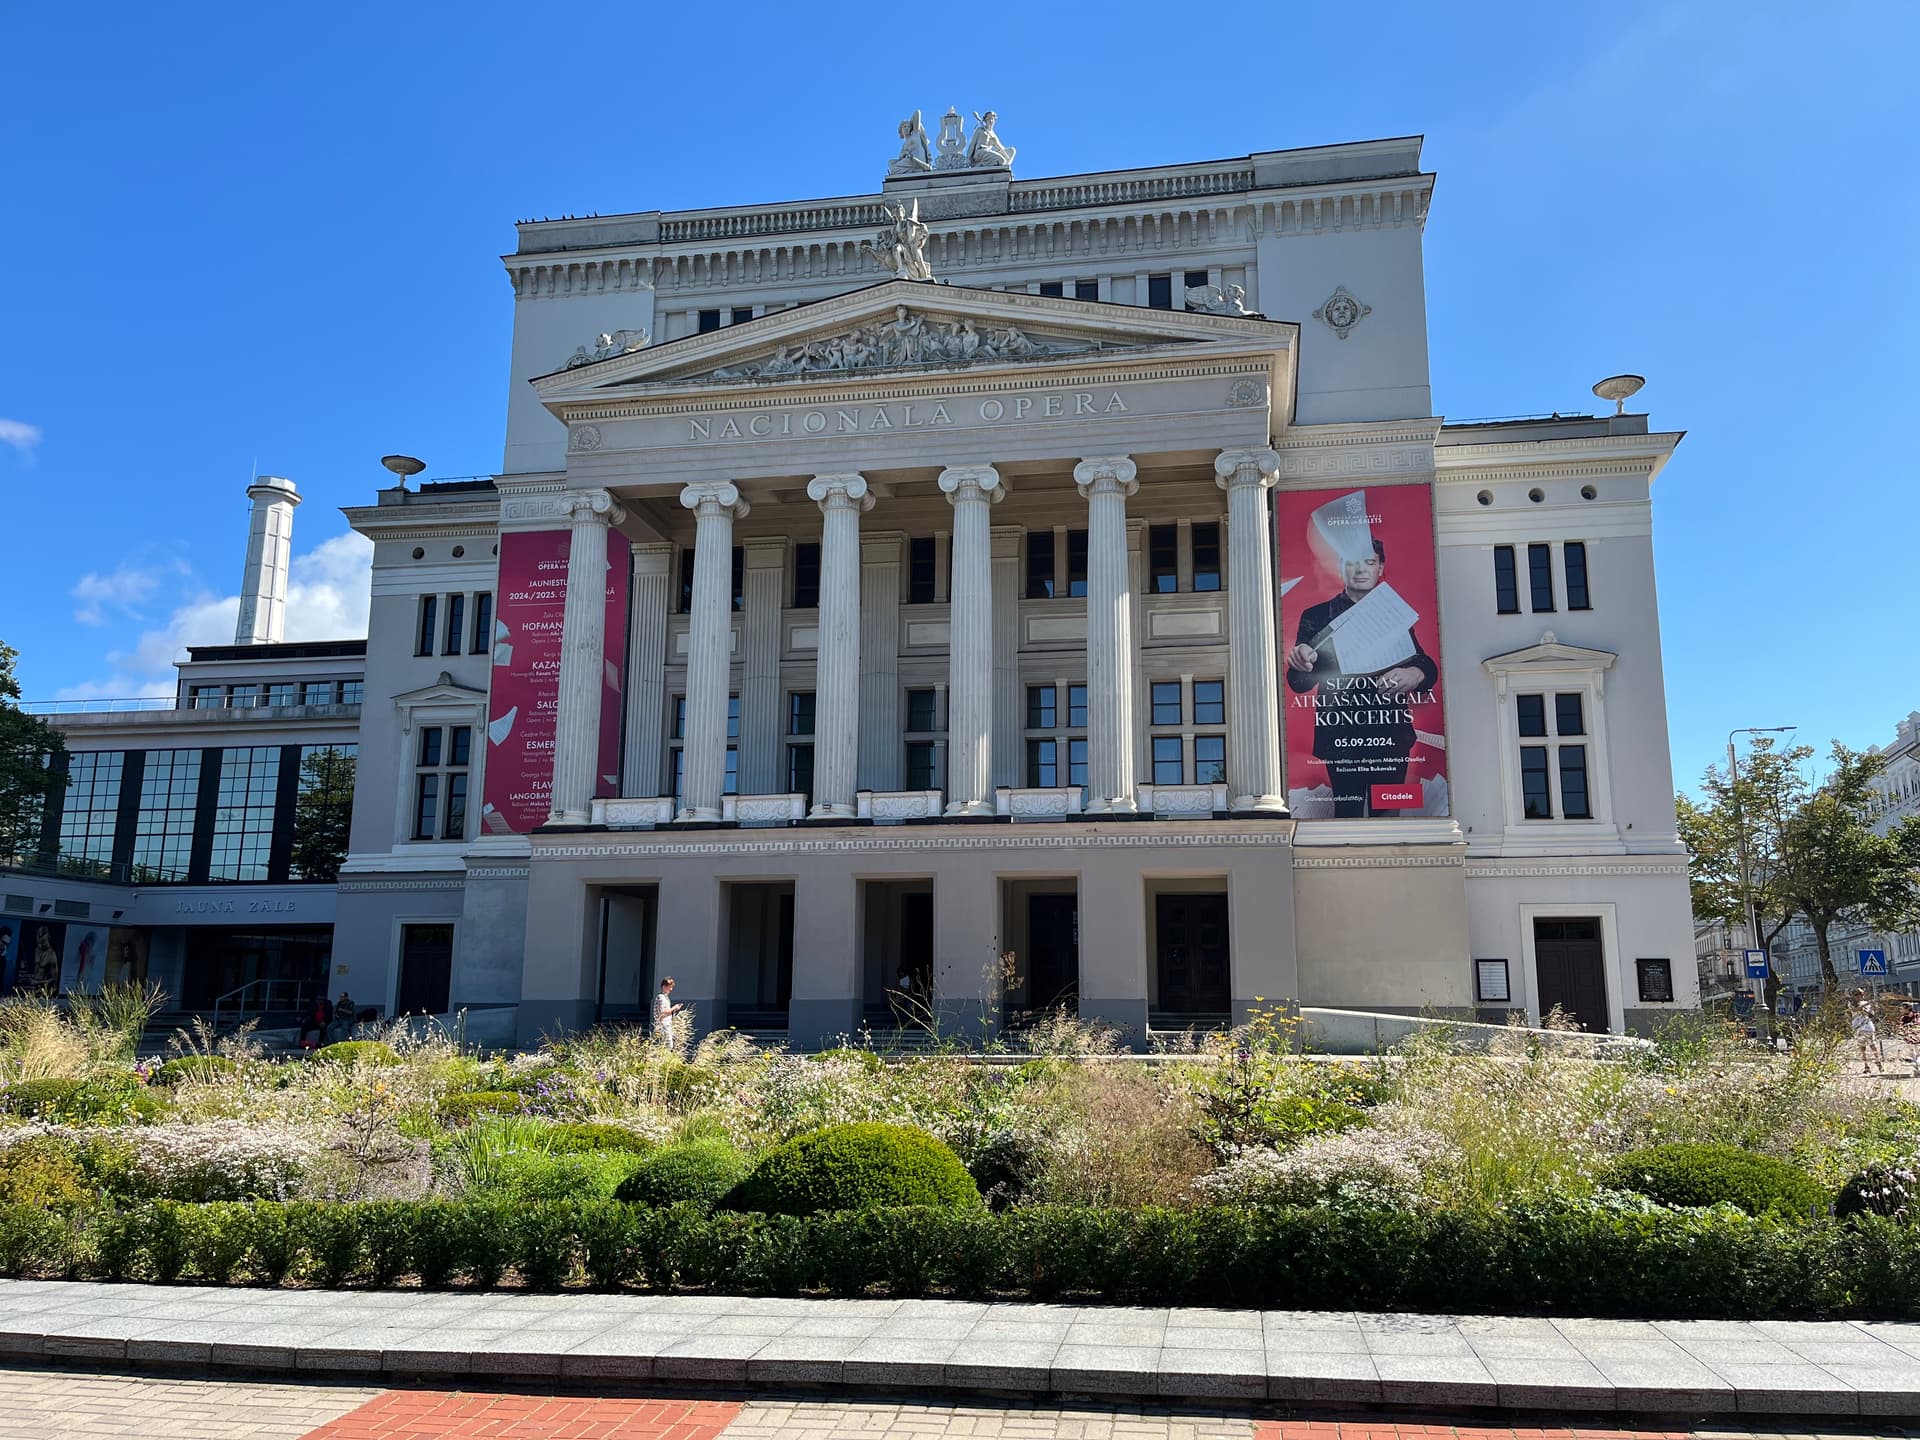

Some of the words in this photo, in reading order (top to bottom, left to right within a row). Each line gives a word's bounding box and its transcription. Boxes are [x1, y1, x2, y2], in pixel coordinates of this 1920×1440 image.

[688, 400, 953, 441] NACIONĀLĀ
[979, 391, 1128, 421] OPERA
[509, 591, 557, 601] 2024./2025.
[1326, 677, 1399, 691] SEZONAS
[1290, 691, 1392, 709] ATKLĀŠANAS
[1394, 688, 1437, 705] GALĀ
[1314, 709, 1415, 727] KONCERTS
[1334, 736, 1396, 748] 05.09.2024.
[1381, 792, 1413, 801] Citadele
[176, 899, 236, 914] JAUNĀ
[248, 898, 297, 913] ZĀLE
